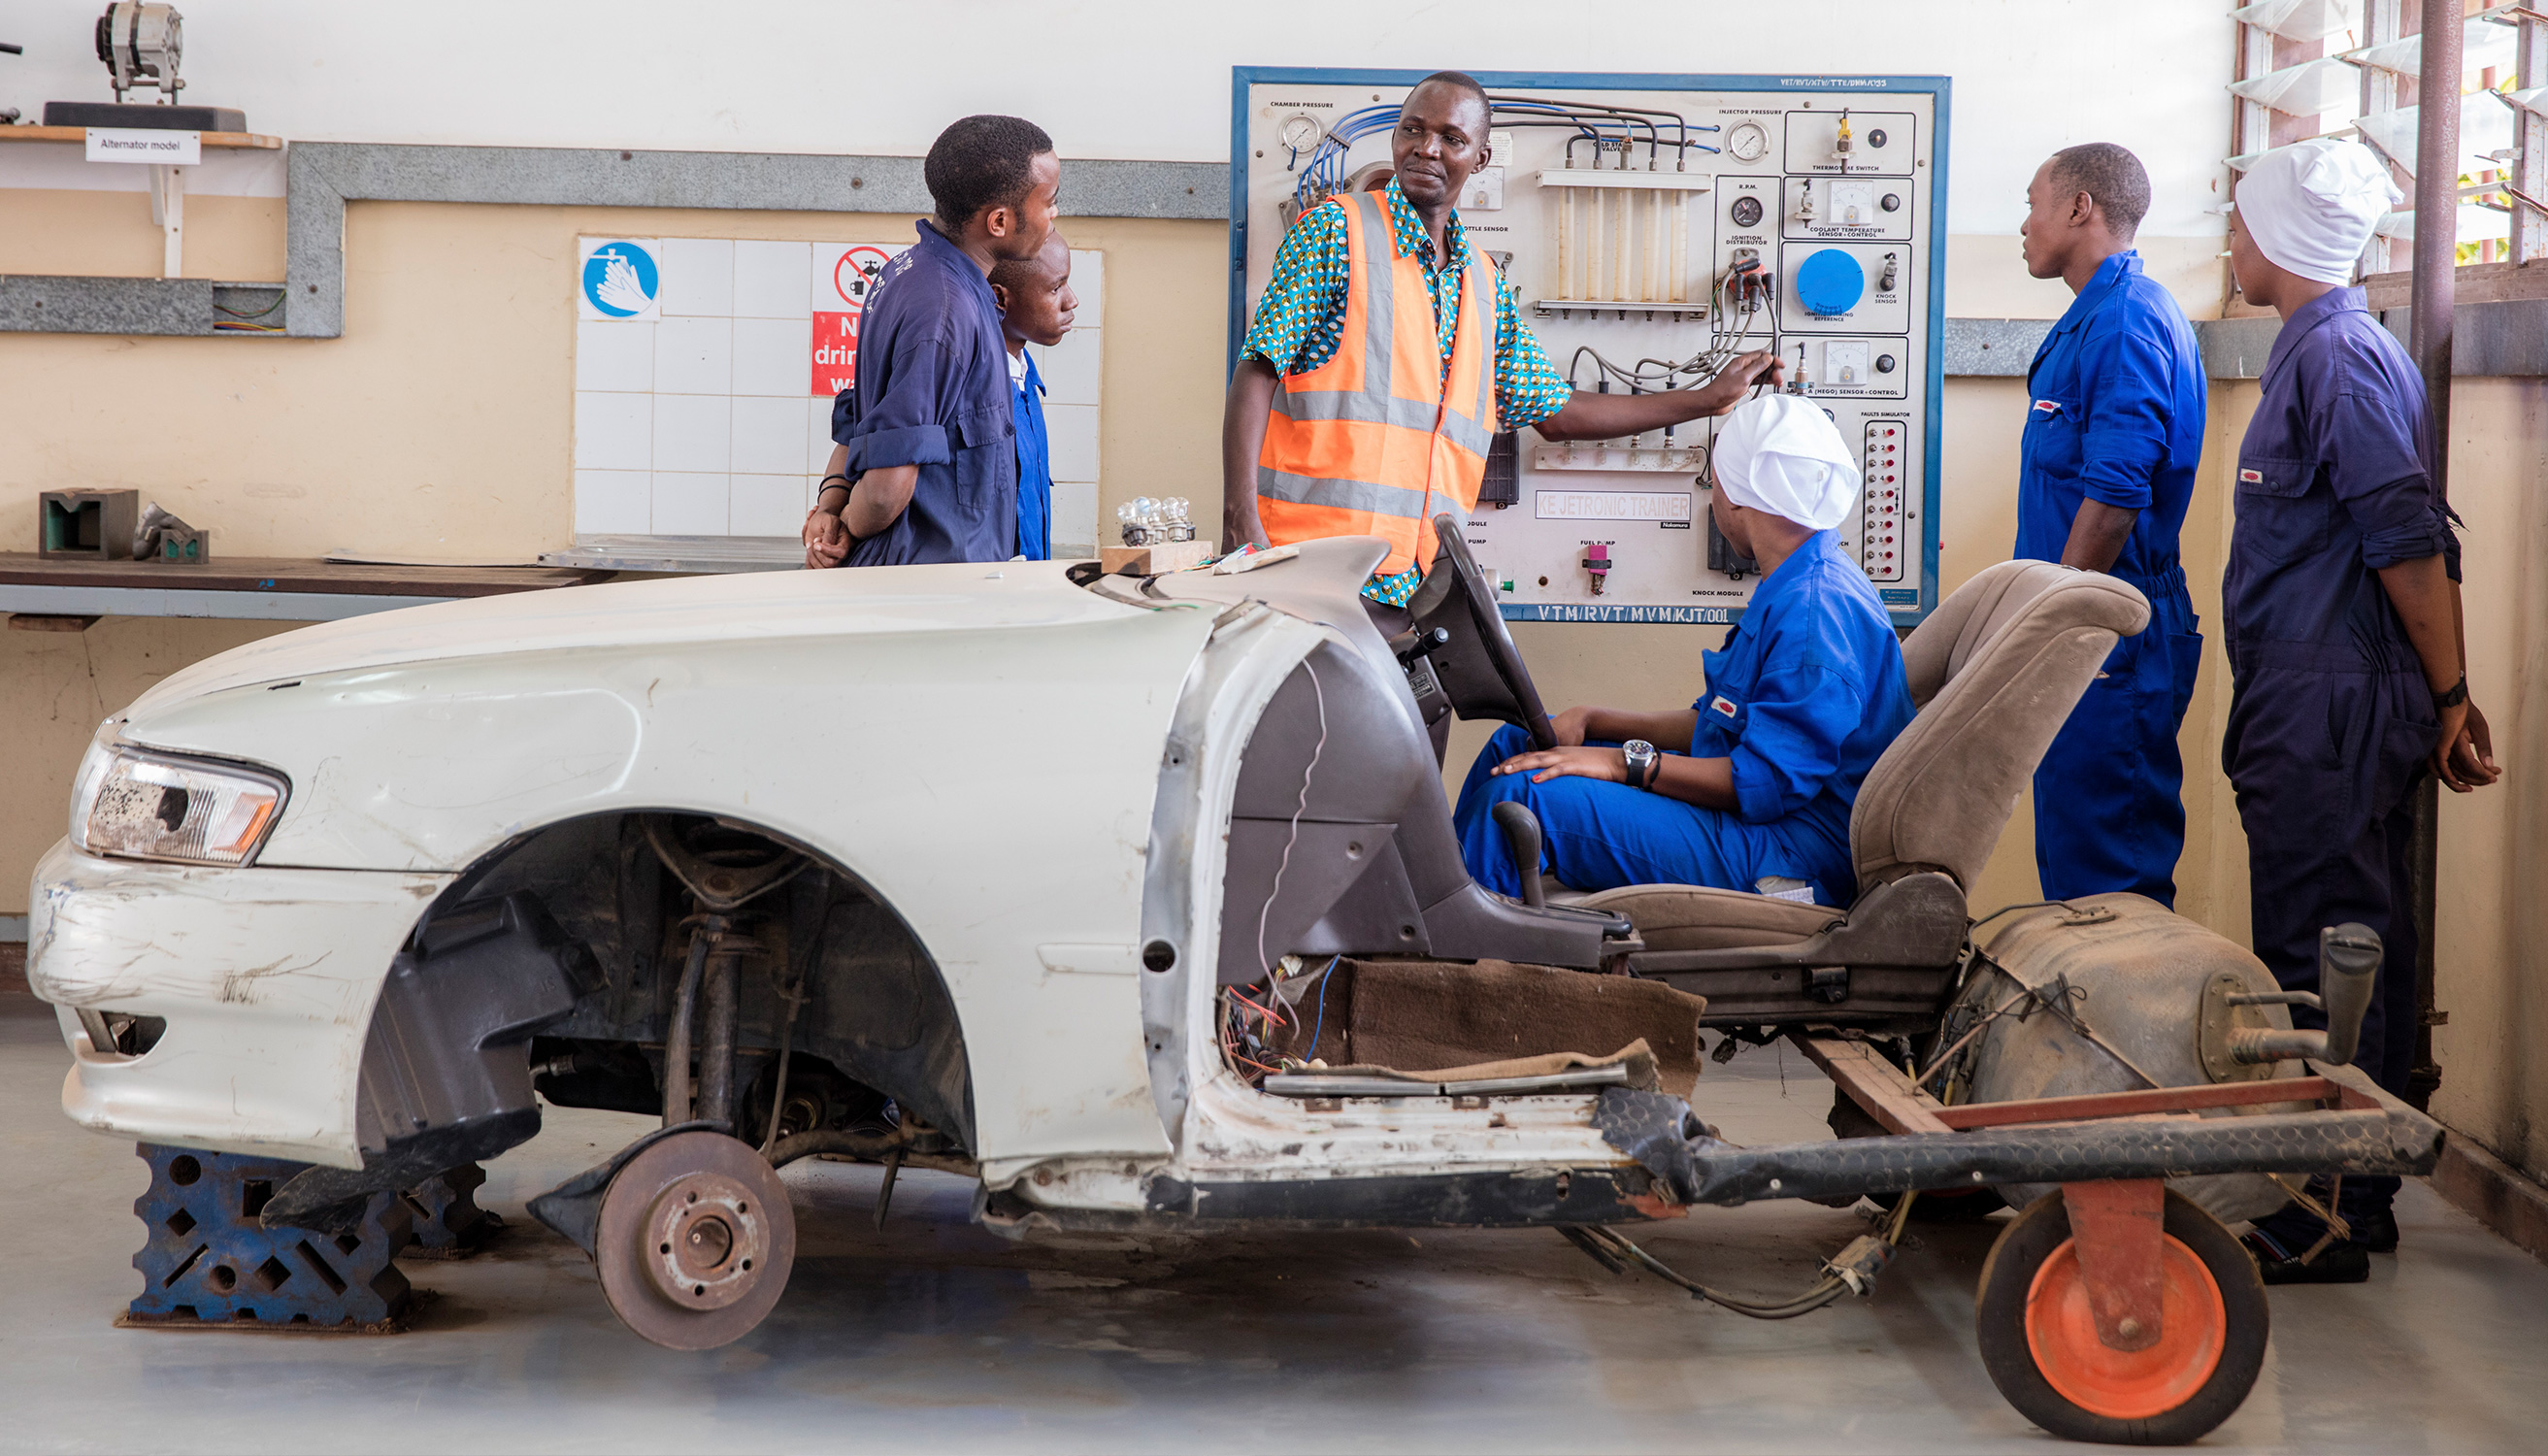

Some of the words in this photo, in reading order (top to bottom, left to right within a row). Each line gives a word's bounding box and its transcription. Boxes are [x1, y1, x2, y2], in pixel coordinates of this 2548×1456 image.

[100, 139, 148, 149] Alternator
[150, 141, 181, 150] model
[1538, 495, 1557, 514] KE
[1559, 495, 1626, 516] JETRONIC
[1630, 496, 1689, 517] TRAINER
